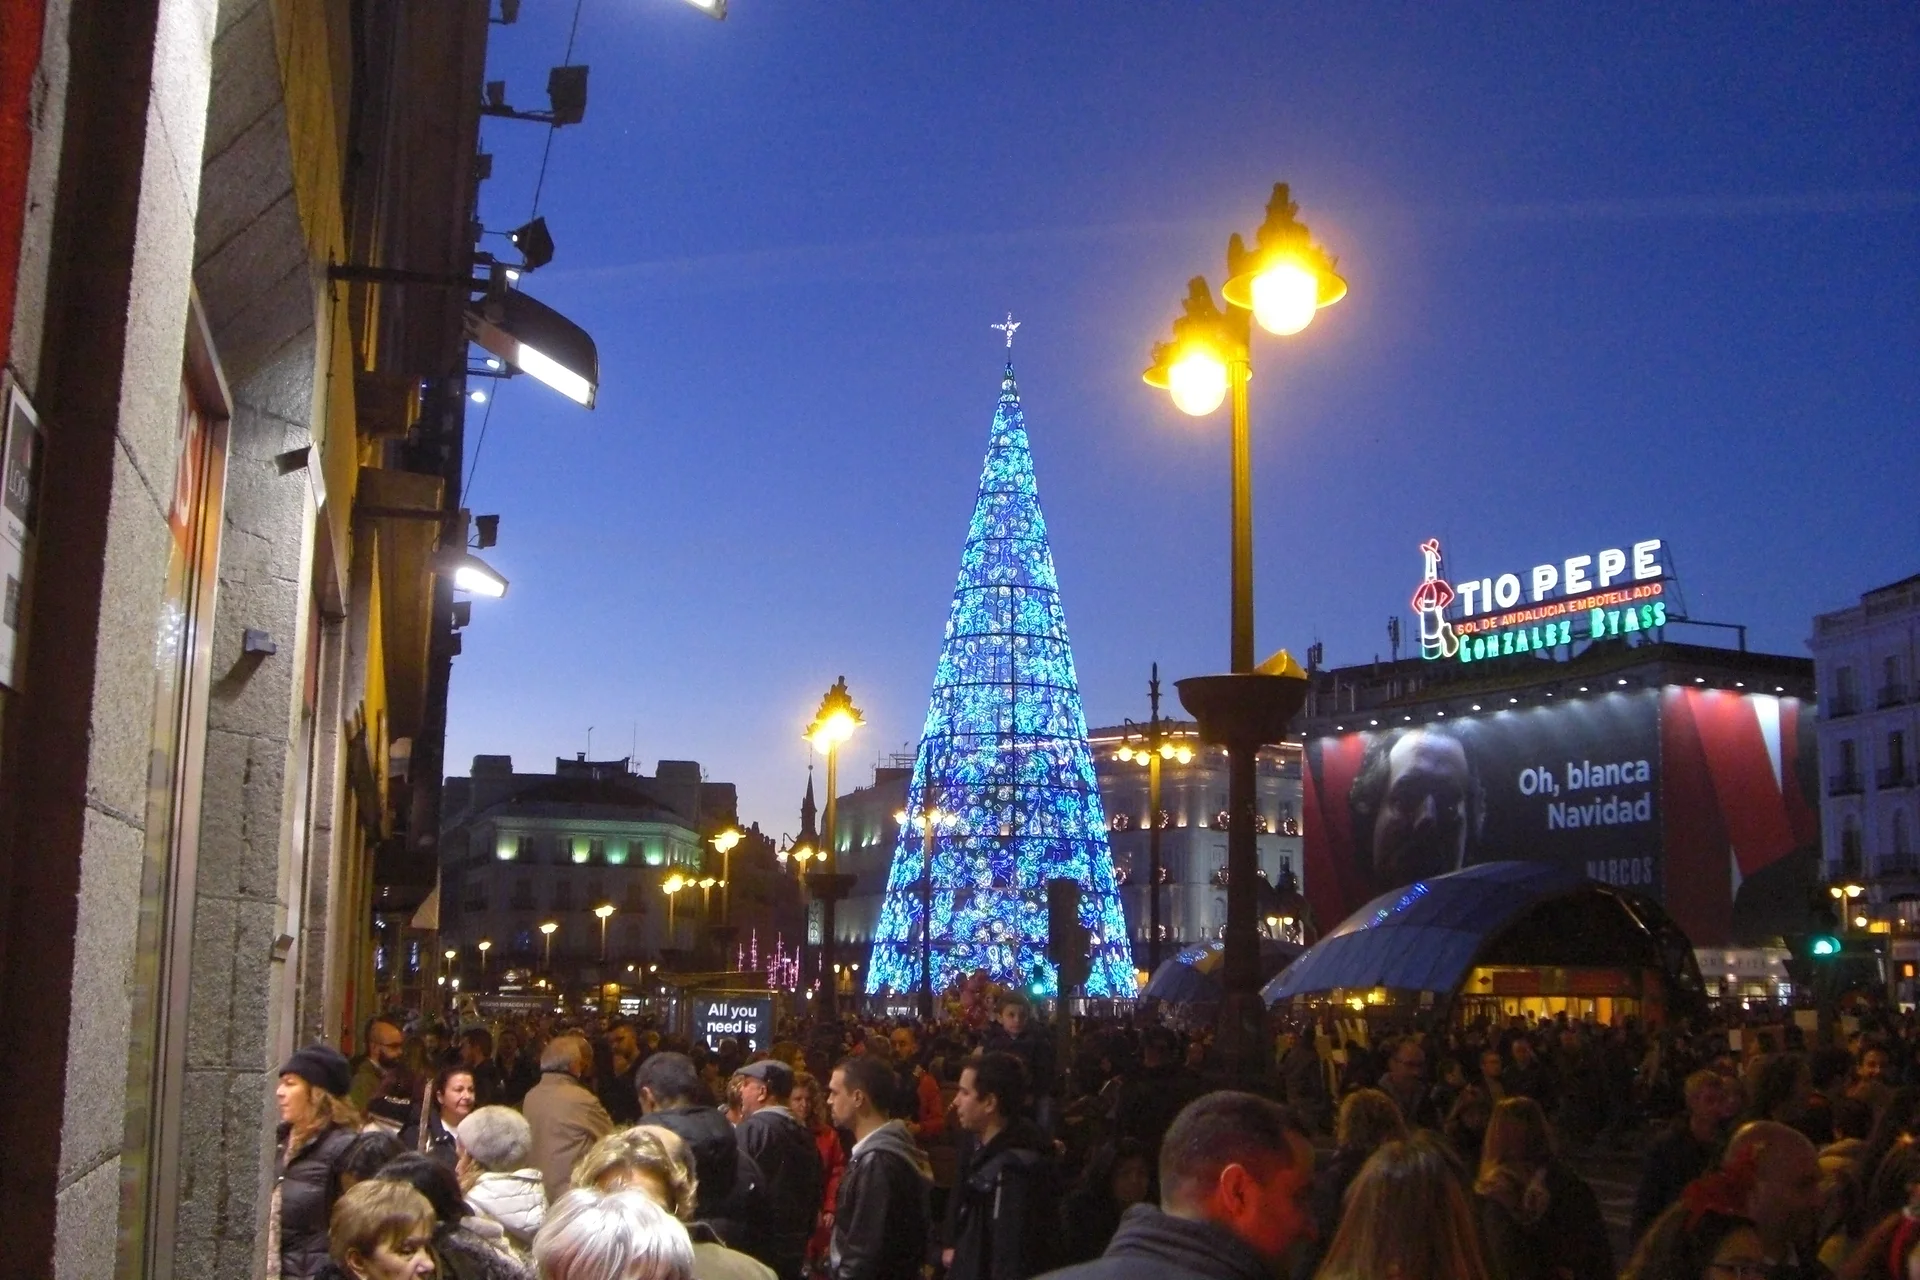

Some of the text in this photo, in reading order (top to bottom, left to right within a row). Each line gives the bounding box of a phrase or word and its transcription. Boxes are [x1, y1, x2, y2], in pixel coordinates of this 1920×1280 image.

[1457, 539, 1662, 616] TIO PEPE
[1457, 584, 1662, 635] SOL DE ANDALUCIA EMBOTELLADO
[1460, 621, 1571, 663] GONZALEZ
[1519, 760, 1650, 797] Oh, blanca
[1549, 792, 1651, 830] Navidad
[1587, 857, 1653, 886] NARCOS
[707, 1020, 757, 1033] need is
[708, 1003, 757, 1019] All you
[707, 1034, 757, 1052] Le
